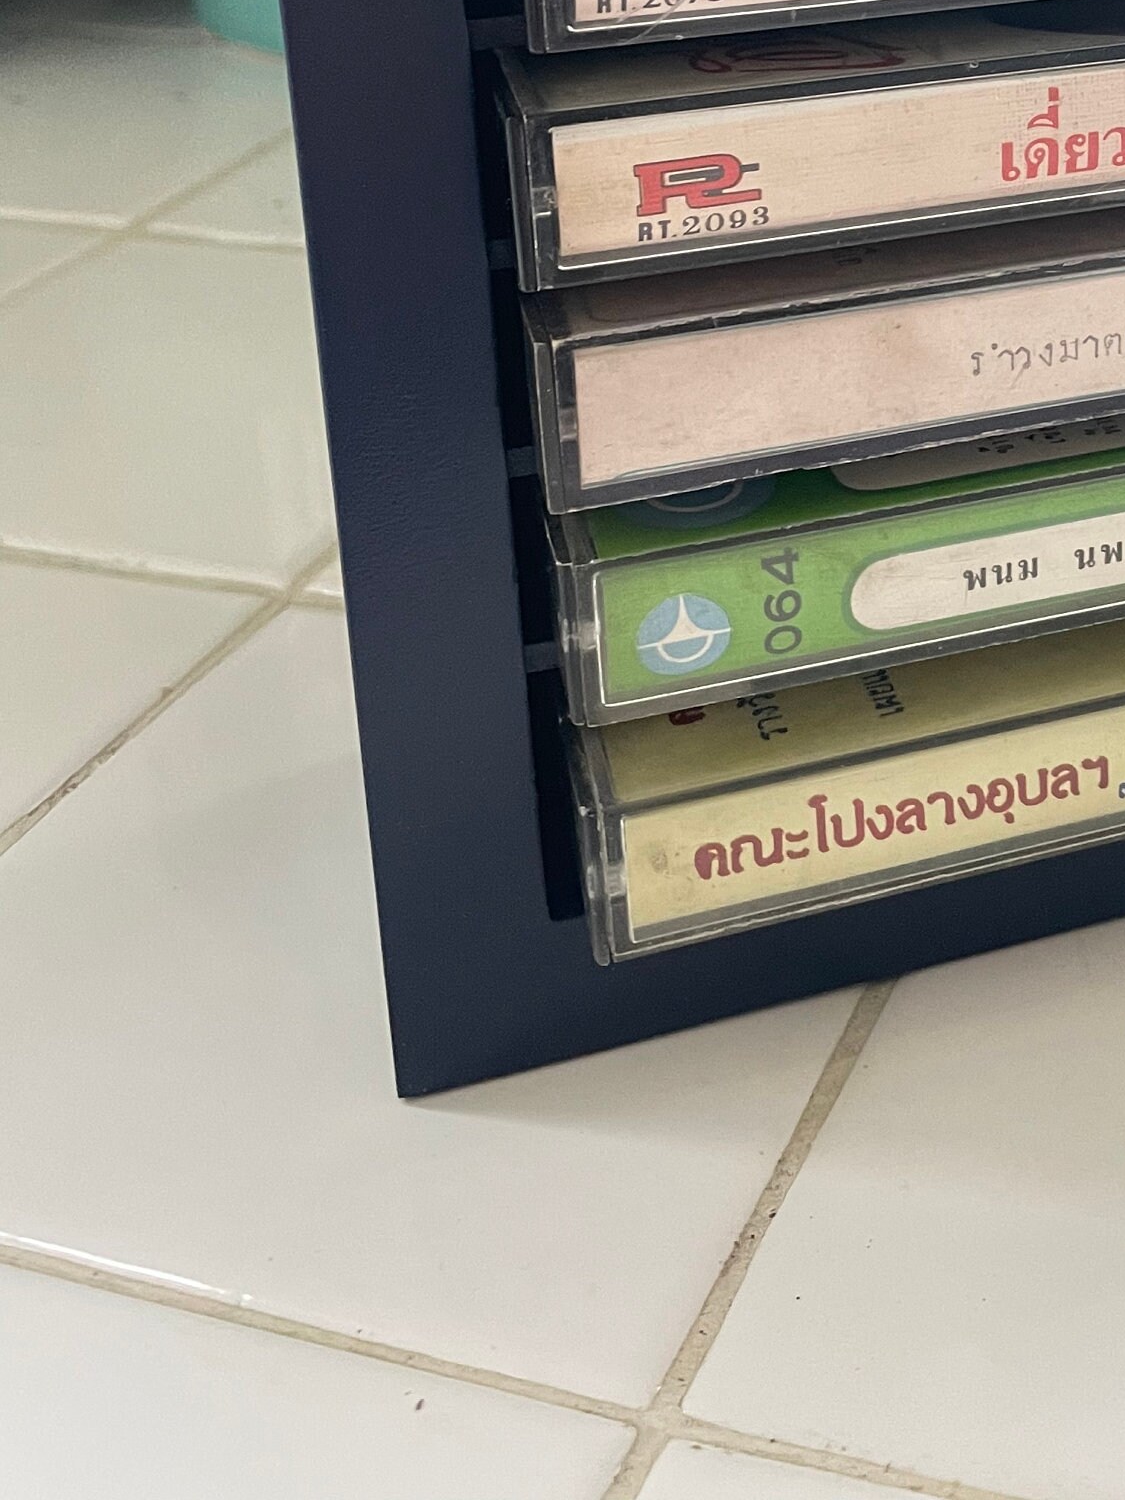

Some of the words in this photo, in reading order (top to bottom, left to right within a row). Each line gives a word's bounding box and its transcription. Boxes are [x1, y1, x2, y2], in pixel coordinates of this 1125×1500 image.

[761, 546, 802, 655] 064
[963, 555, 1039, 591] พนม
[695, 755, 1109, 879] คณะโปงลางอุบลฯ
